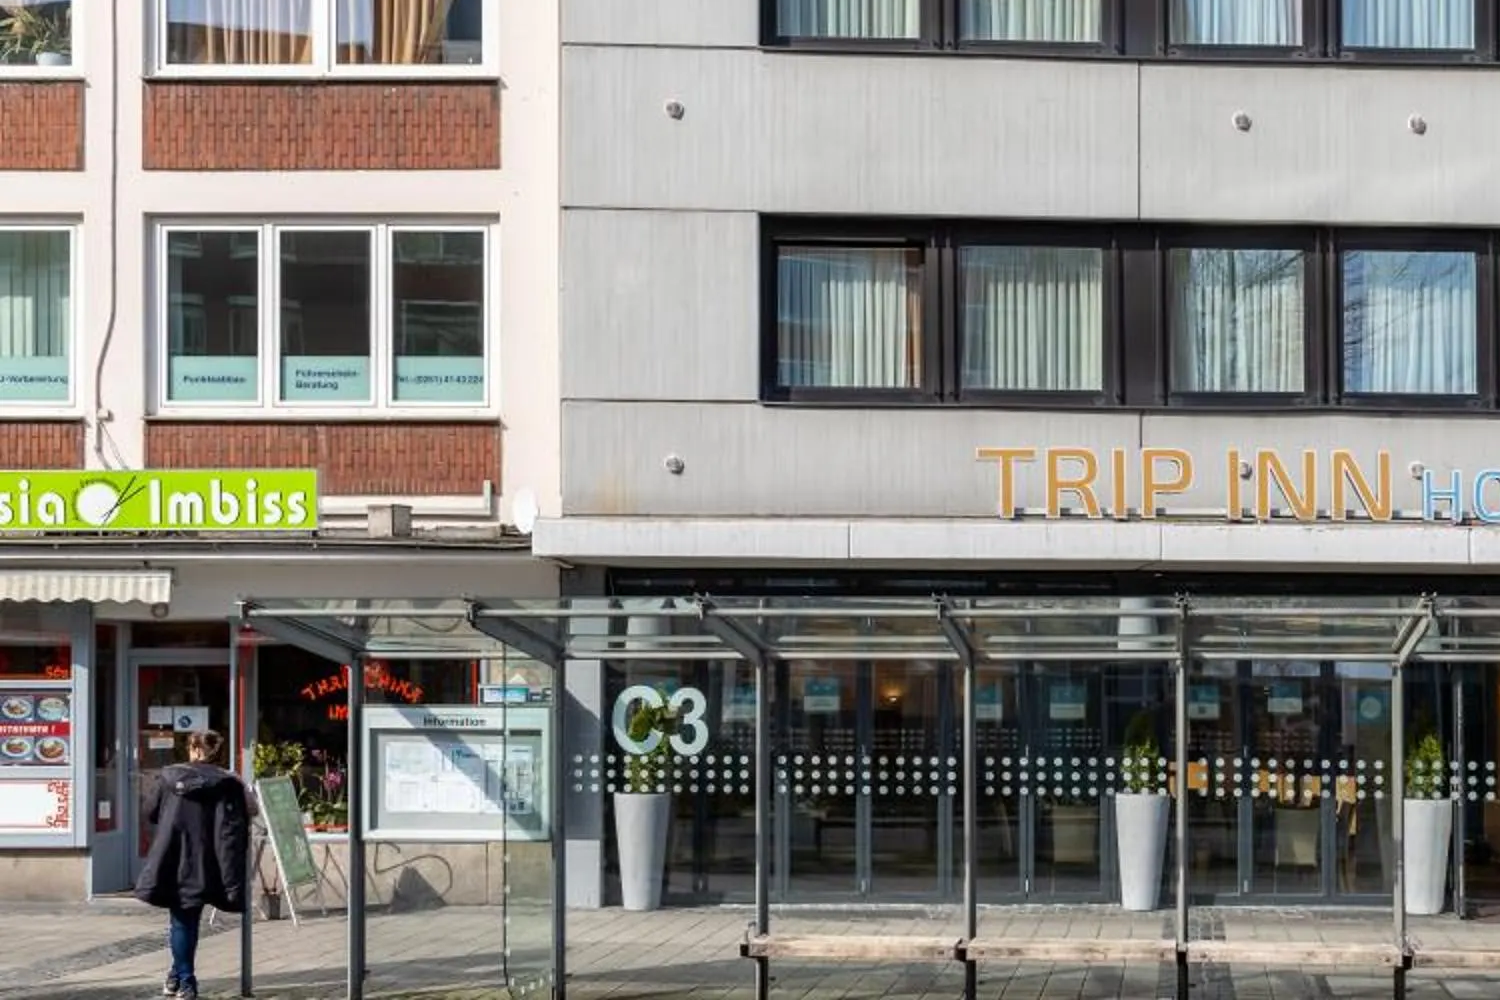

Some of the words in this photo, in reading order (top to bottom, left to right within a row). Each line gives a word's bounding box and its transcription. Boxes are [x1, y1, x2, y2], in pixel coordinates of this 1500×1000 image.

[150, 478, 308, 525] Imbiss
[976, 447, 1194, 521] TRIP
[1228, 447, 1392, 521] INN
[423, 716, 487, 727] Information
